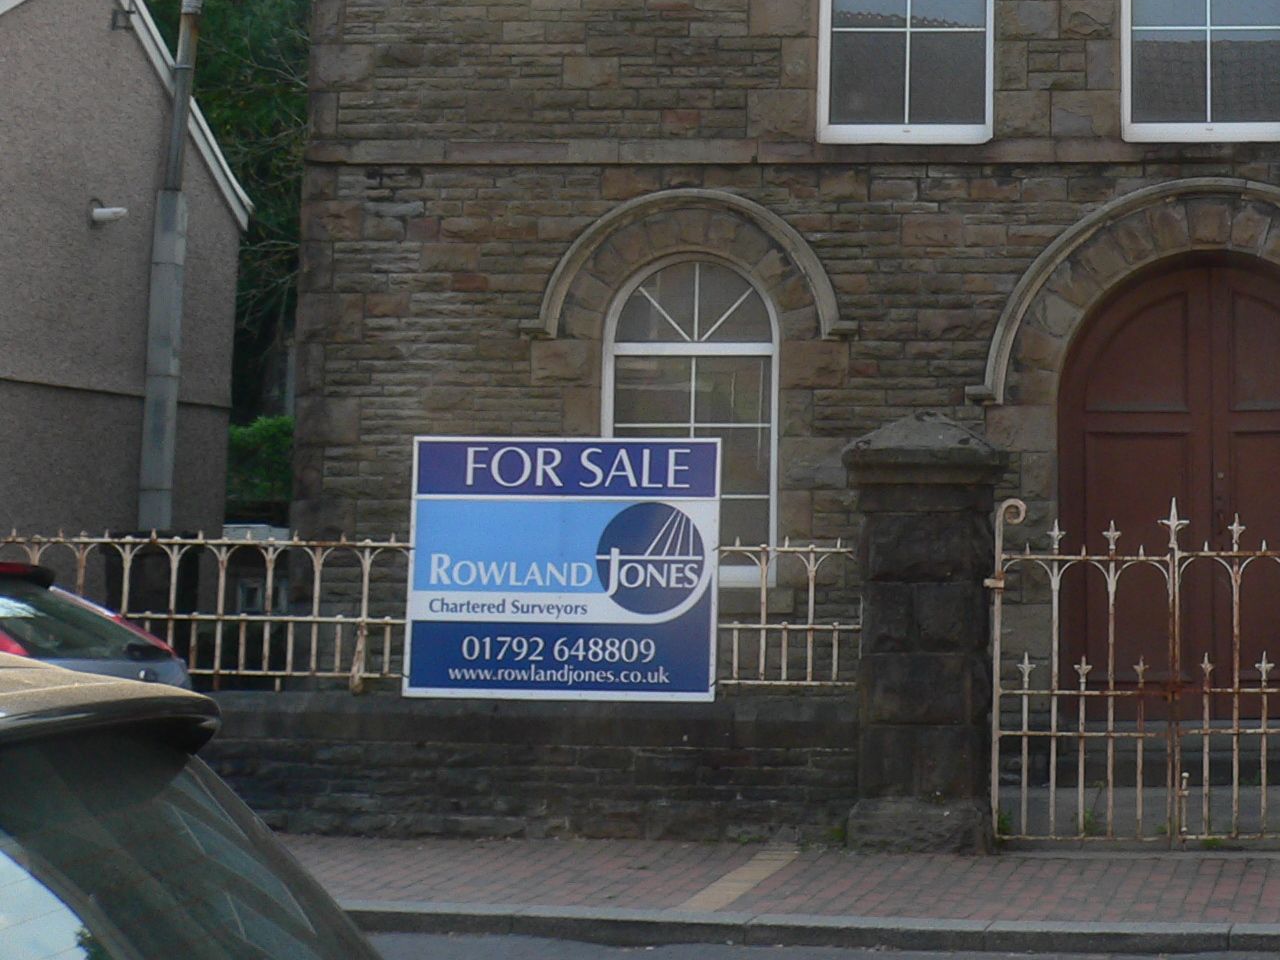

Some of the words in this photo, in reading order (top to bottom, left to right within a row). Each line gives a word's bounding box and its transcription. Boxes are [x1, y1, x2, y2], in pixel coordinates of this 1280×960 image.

[465, 446, 564, 487] FOR
[579, 447, 692, 488] SALE
[429, 553, 593, 587] ROWLAND
[607, 547, 699, 597] JONES
[429, 598, 505, 615] Chartered
[511, 599, 588, 619] Surveyors
[461, 636, 544, 662] 01792
[553, 637, 656, 663] 648809
[448, 664, 671, 686] www.rowlandjones.co.uk
